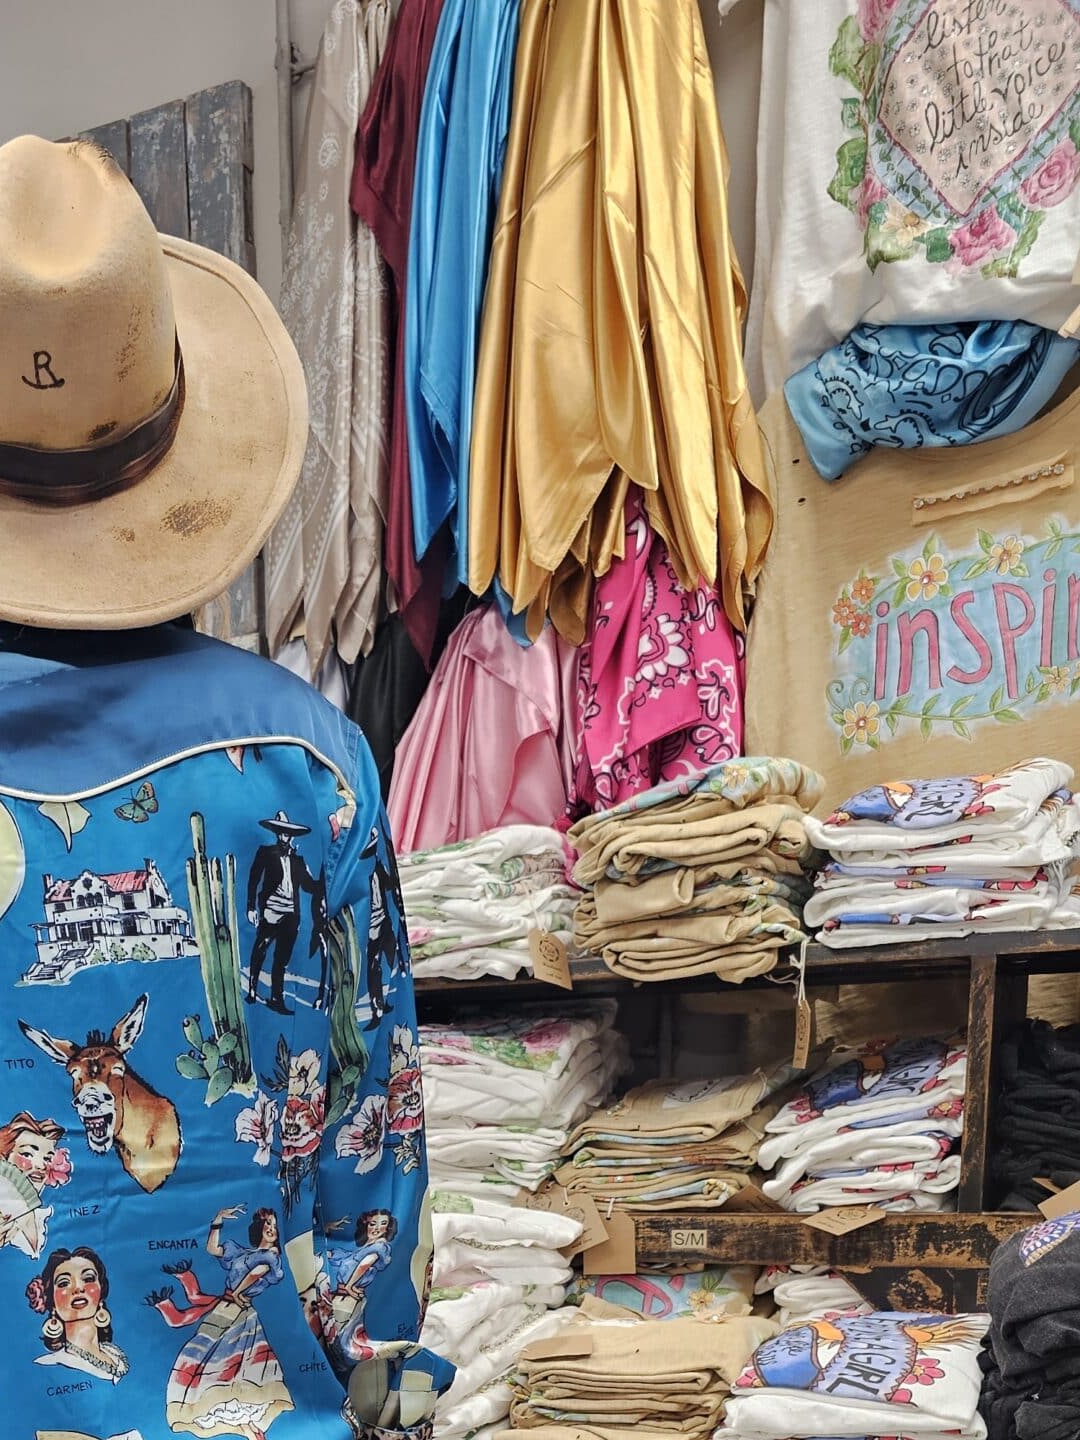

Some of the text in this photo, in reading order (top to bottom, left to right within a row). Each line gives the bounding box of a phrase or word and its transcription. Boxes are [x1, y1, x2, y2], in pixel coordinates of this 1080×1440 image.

[925, 41, 1066, 155] little voice
[955, 102, 1044, 179] inside
[4, 1058, 35, 1070] TITO
[148, 1238, 199, 1251] ENCANTA
[673, 1232, 705, 1246] S/M
[46, 1380, 93, 1397] CARMEN
